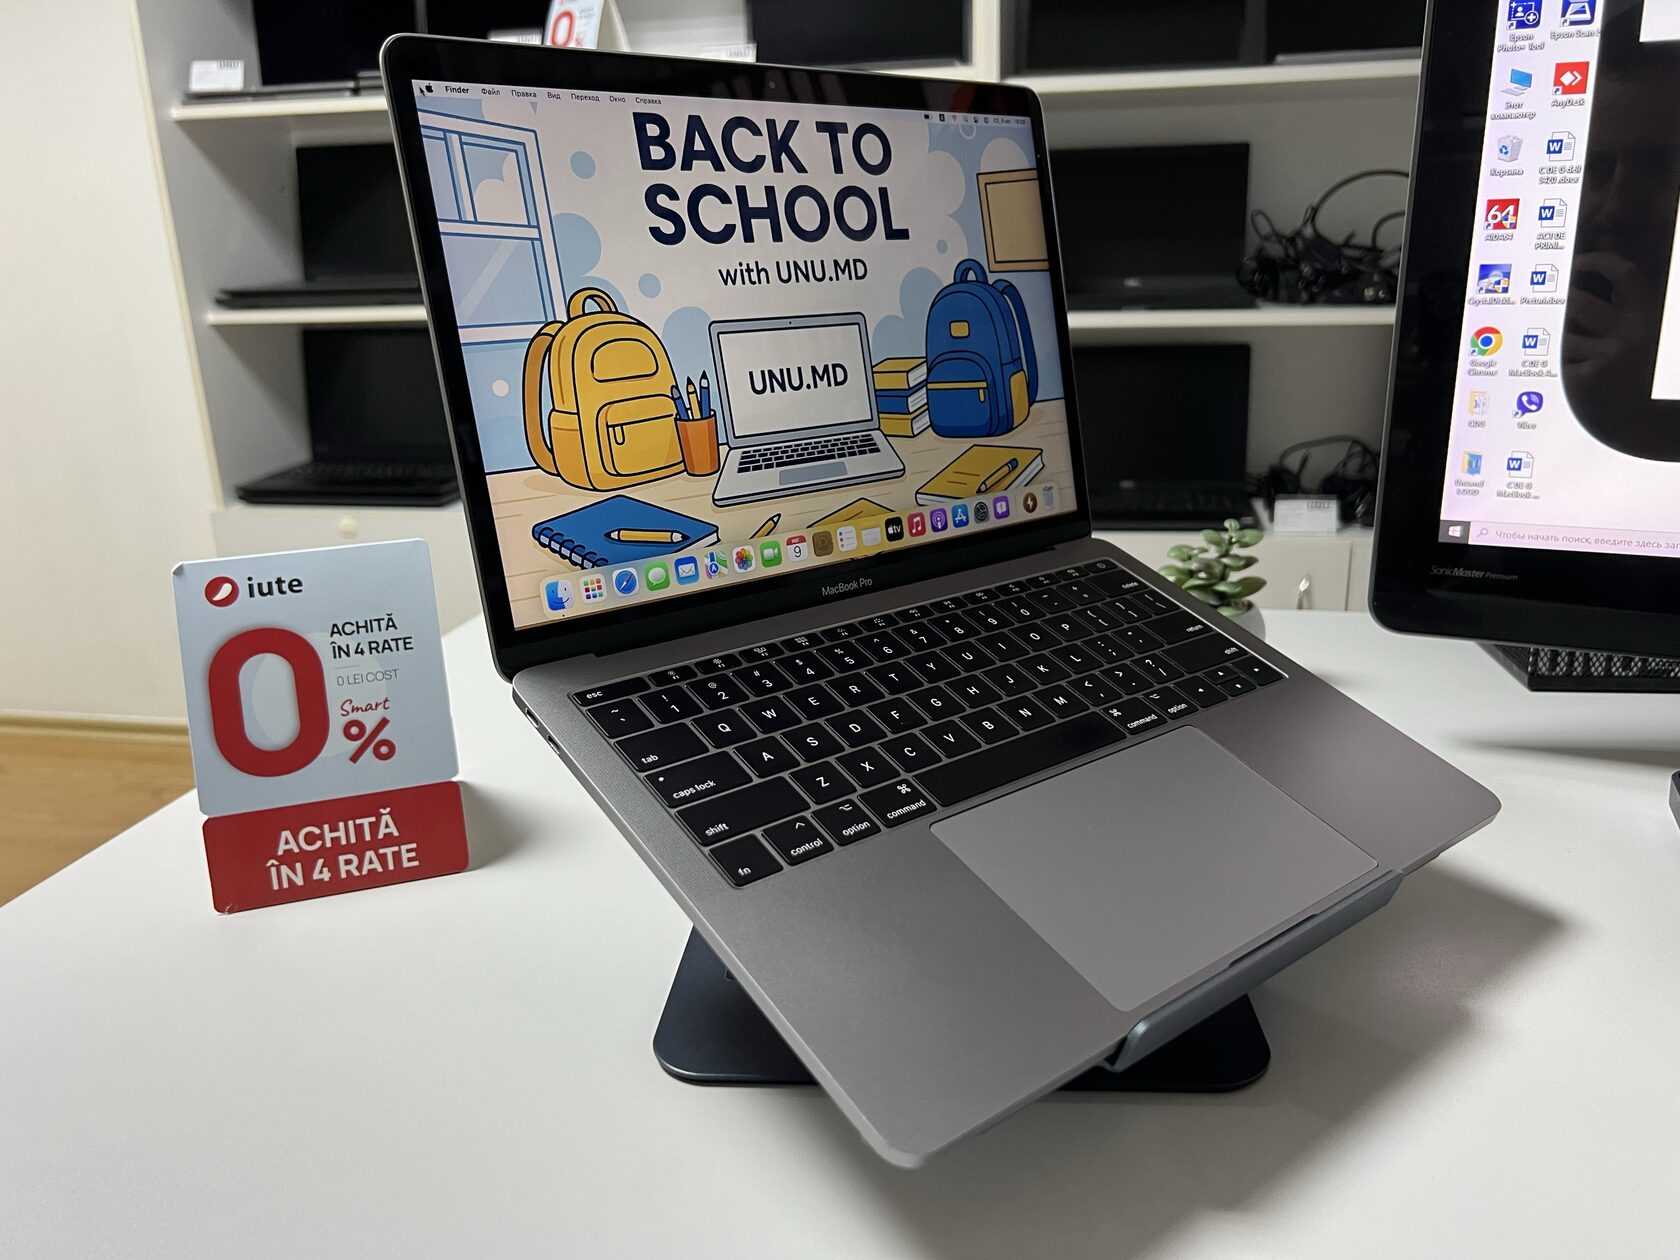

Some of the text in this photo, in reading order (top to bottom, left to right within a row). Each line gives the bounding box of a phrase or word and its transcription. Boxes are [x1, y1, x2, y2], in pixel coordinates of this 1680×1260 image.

[1509, 34, 1534, 42] Epson
[1551, 31, 1574, 41] Epson
[1575, 30, 1595, 38] Scan
[1528, 43, 1545, 51] Tool
[445, 86, 470, 94] Finder
[481, 87, 500, 96] Файл
[511, 89, 537, 98] Правка
[547, 91, 561, 100] Вид
[570, 93, 600, 102] Переход
[609, 95, 626, 103] Окно
[635, 96, 662, 105] Справка
[1551, 99, 1585, 108] AnyDesk
[1490, 111, 1536, 120] компьютер
[632, 111, 892, 176] BACK TO
[1490, 168, 1524, 177] Корзина
[644, 183, 910, 246] SCHOOL
[718, 259, 868, 286] with UNU.MD
[748, 363, 848, 395] UNU.MD
[1496, 530, 1525, 540] Чтобы
[1527, 533, 1559, 543] начать
[1562, 535, 1592, 545] поиск,
[1595, 538, 1633, 547] введите
[1635, 540, 1662, 549] здесь
[793, 545, 802, 558] 9
[1430, 564, 1518, 581] SonicMaster Premium
[247, 577, 304, 599] iute
[822, 577, 873, 597] MacBook Pro
[329, 613, 398, 637] ACHITĂ
[330, 636, 414, 659] ÎN 4 RATE
[337, 669, 400, 686] 0 LEI COST
[586, 690, 602, 698] esc
[208, 627, 330, 778] 0
[808, 697, 819, 705] E
[1054, 697, 1067, 705] M
[340, 696, 391, 717] Smart
[1168, 704, 1187, 713] option
[762, 709, 776, 718] W
[891, 711, 899, 719] F
[1019, 709, 1032, 717] N
[982, 721, 994, 729] B
[1128, 714, 1158, 728] command
[718, 724, 731, 732] Q
[849, 724, 861, 732] D
[807, 737, 818, 746] S
[943, 734, 954, 742] V
[762, 752, 774, 761] A
[904, 748, 916, 756] C
[642, 755, 658, 763] tab
[861, 762, 874, 771] X
[816, 777, 829, 787] Z
[672, 781, 717, 799] caps lock
[887, 801, 927, 818] command
[277, 807, 400, 856] ACHITĂ
[706, 822, 730, 836] shift
[843, 821, 871, 835] option
[791, 840, 824, 856] control
[266, 842, 420, 890] ÎN 4 RATE
[738, 866, 752, 876] fn
